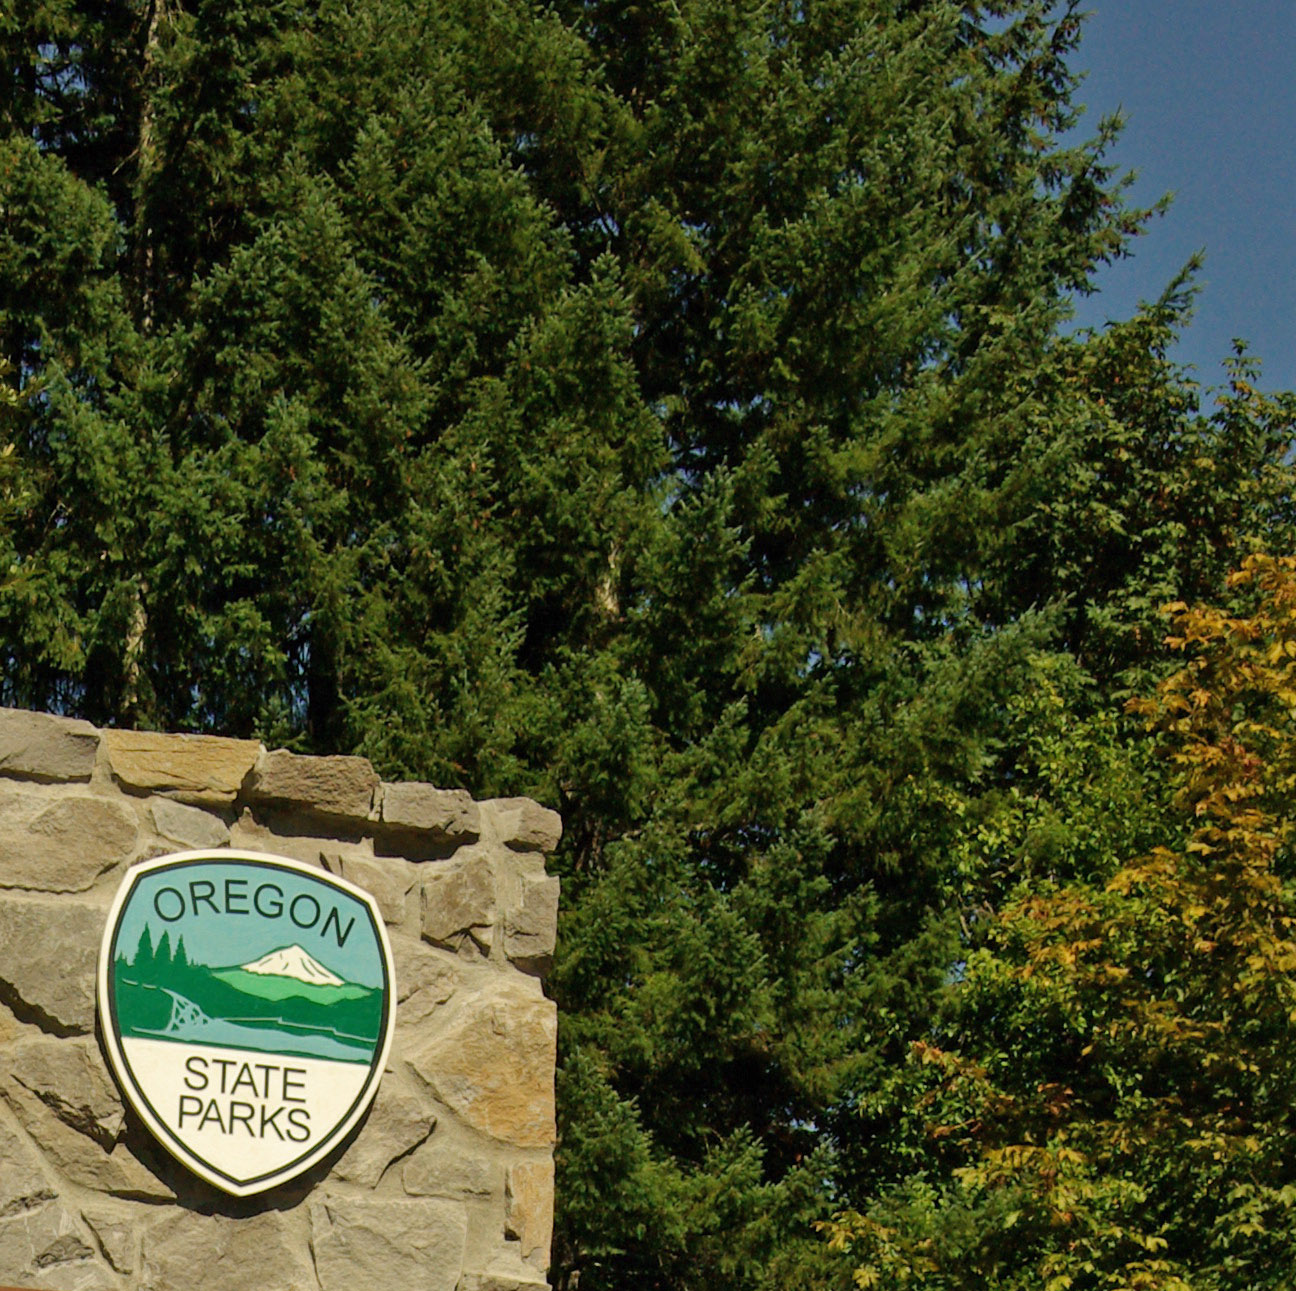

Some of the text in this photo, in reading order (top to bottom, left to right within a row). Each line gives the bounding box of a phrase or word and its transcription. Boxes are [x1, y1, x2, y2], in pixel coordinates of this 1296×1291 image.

[153, 879, 356, 948] OREGON
[183, 1056, 307, 1103] STATE
[177, 1095, 311, 1143] PARKS
